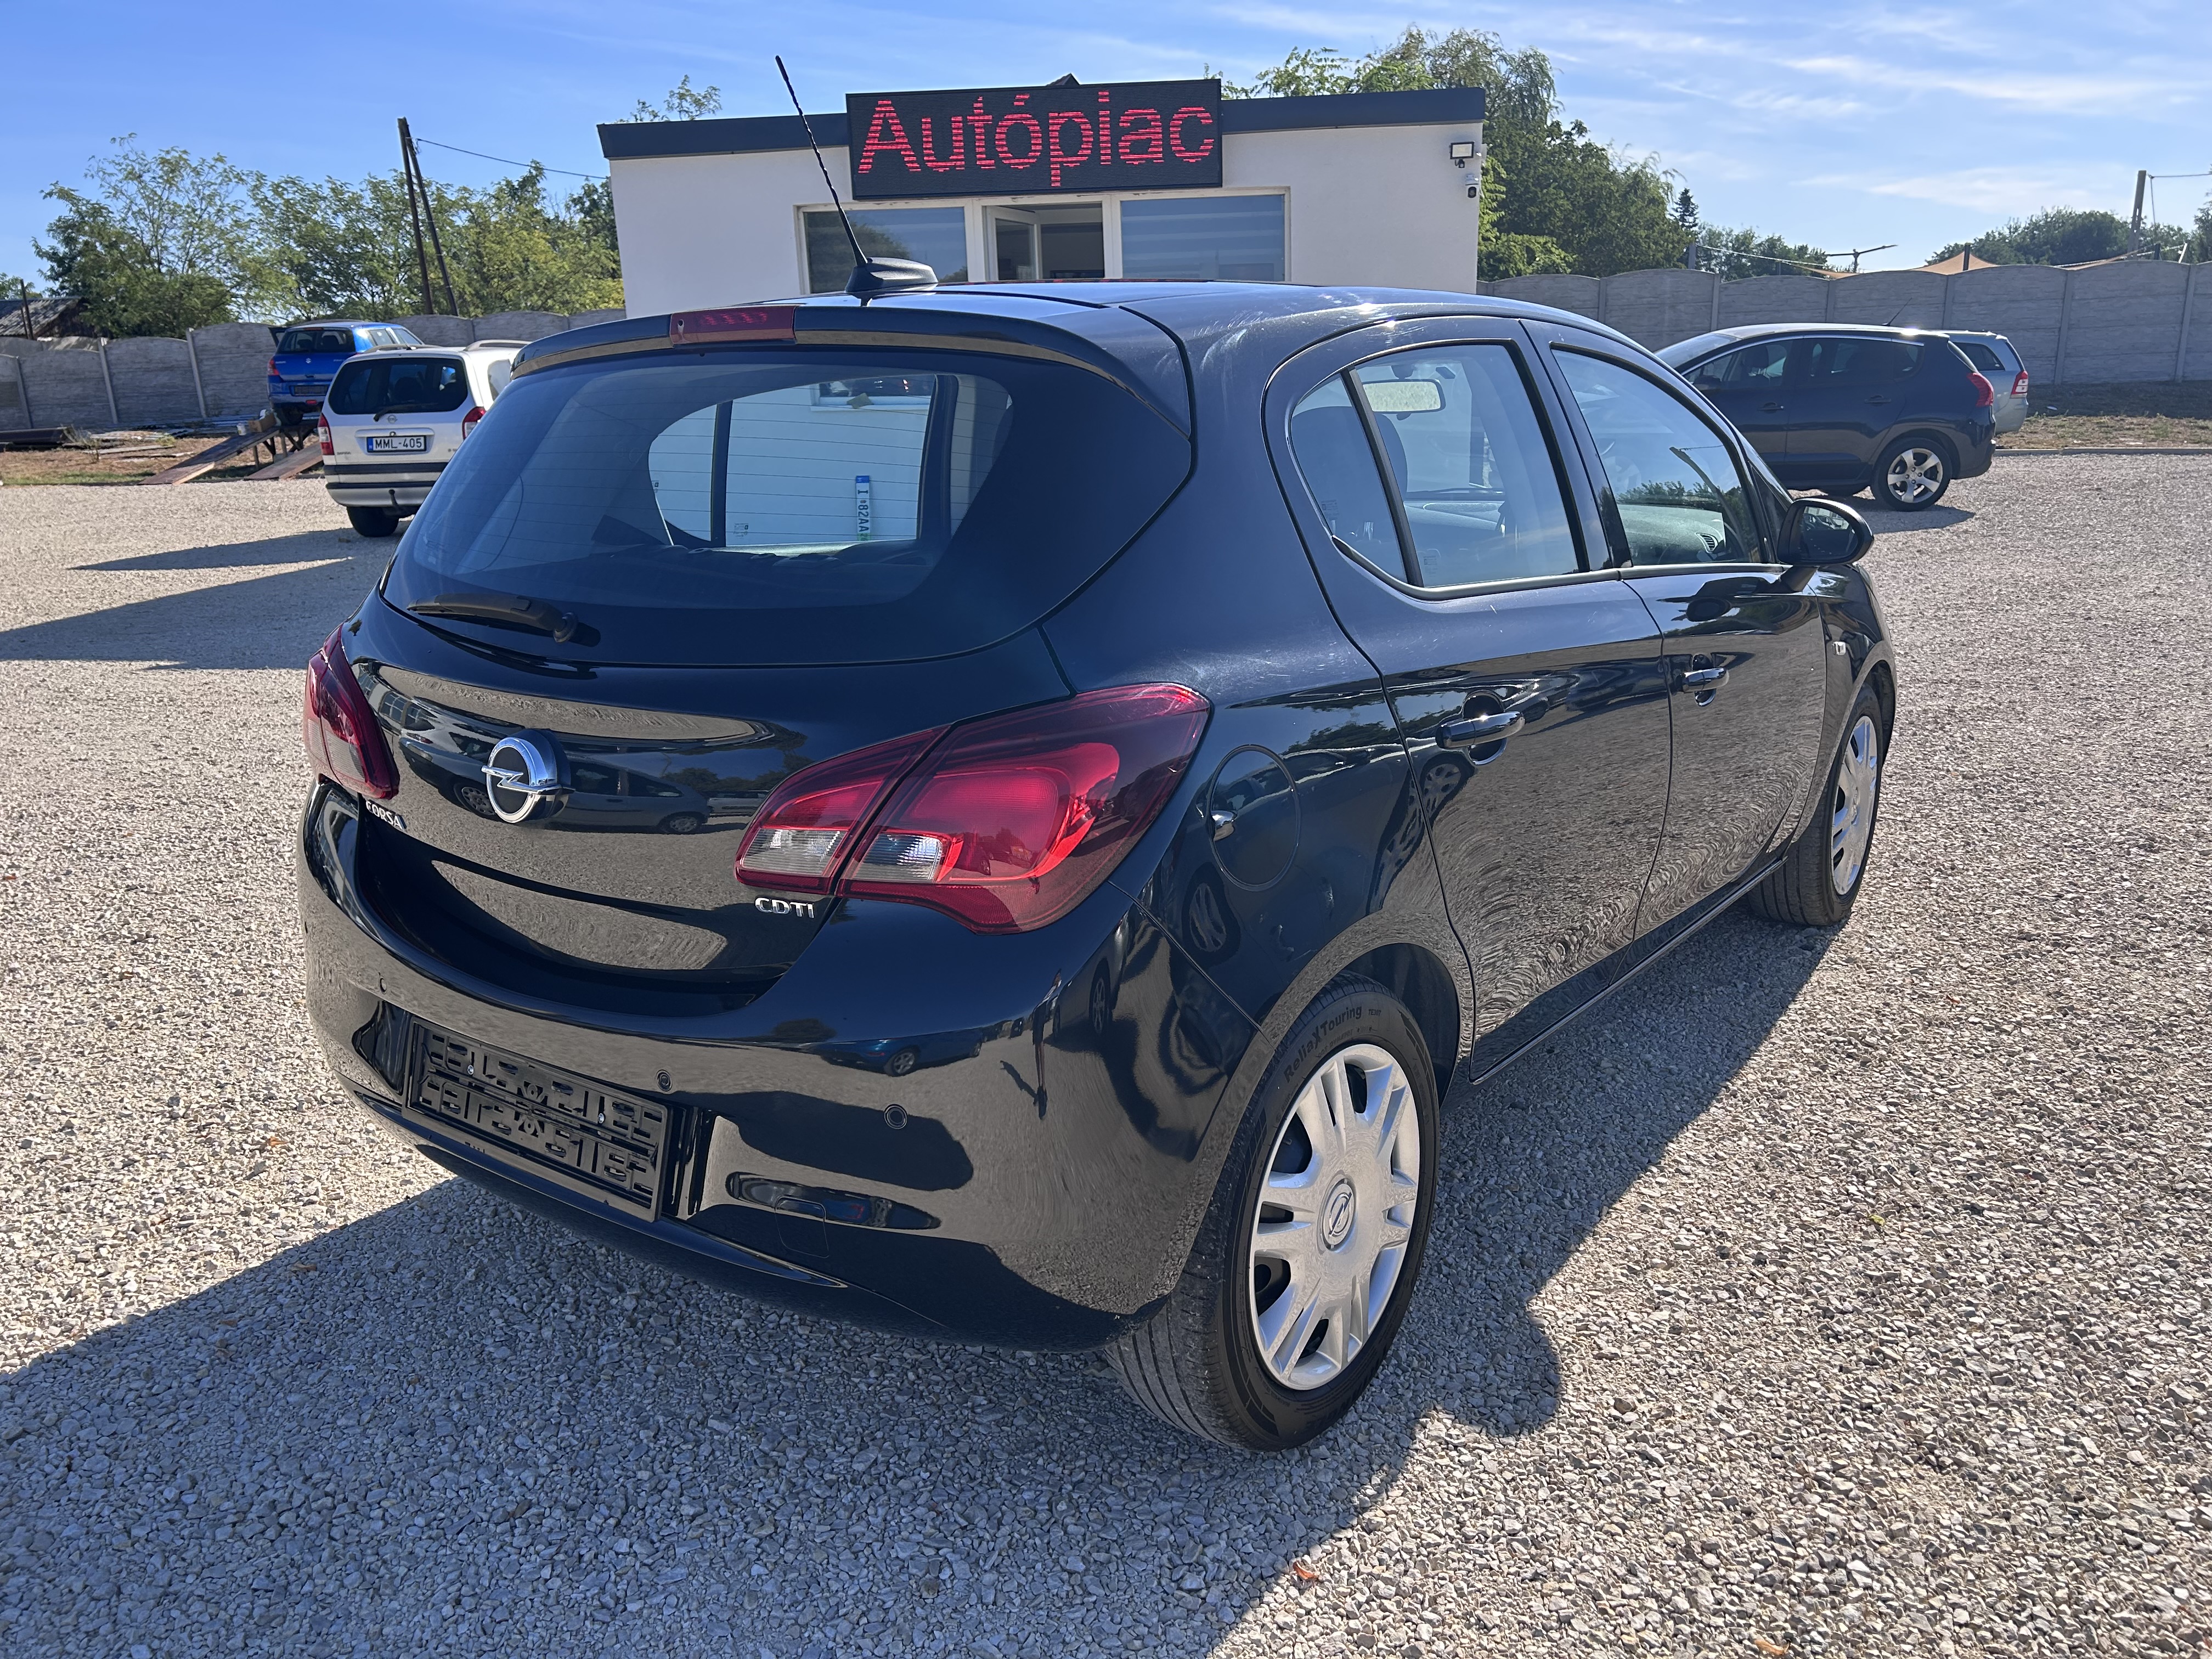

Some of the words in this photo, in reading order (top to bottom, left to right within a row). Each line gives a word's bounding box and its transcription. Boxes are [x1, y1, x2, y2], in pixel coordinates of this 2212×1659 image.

[858, 91, 1214, 187] Autópiac
[375, 437, 422, 450] MML-405
[365, 800, 403, 830] CORSA
[755, 897, 815, 919] CDTI
